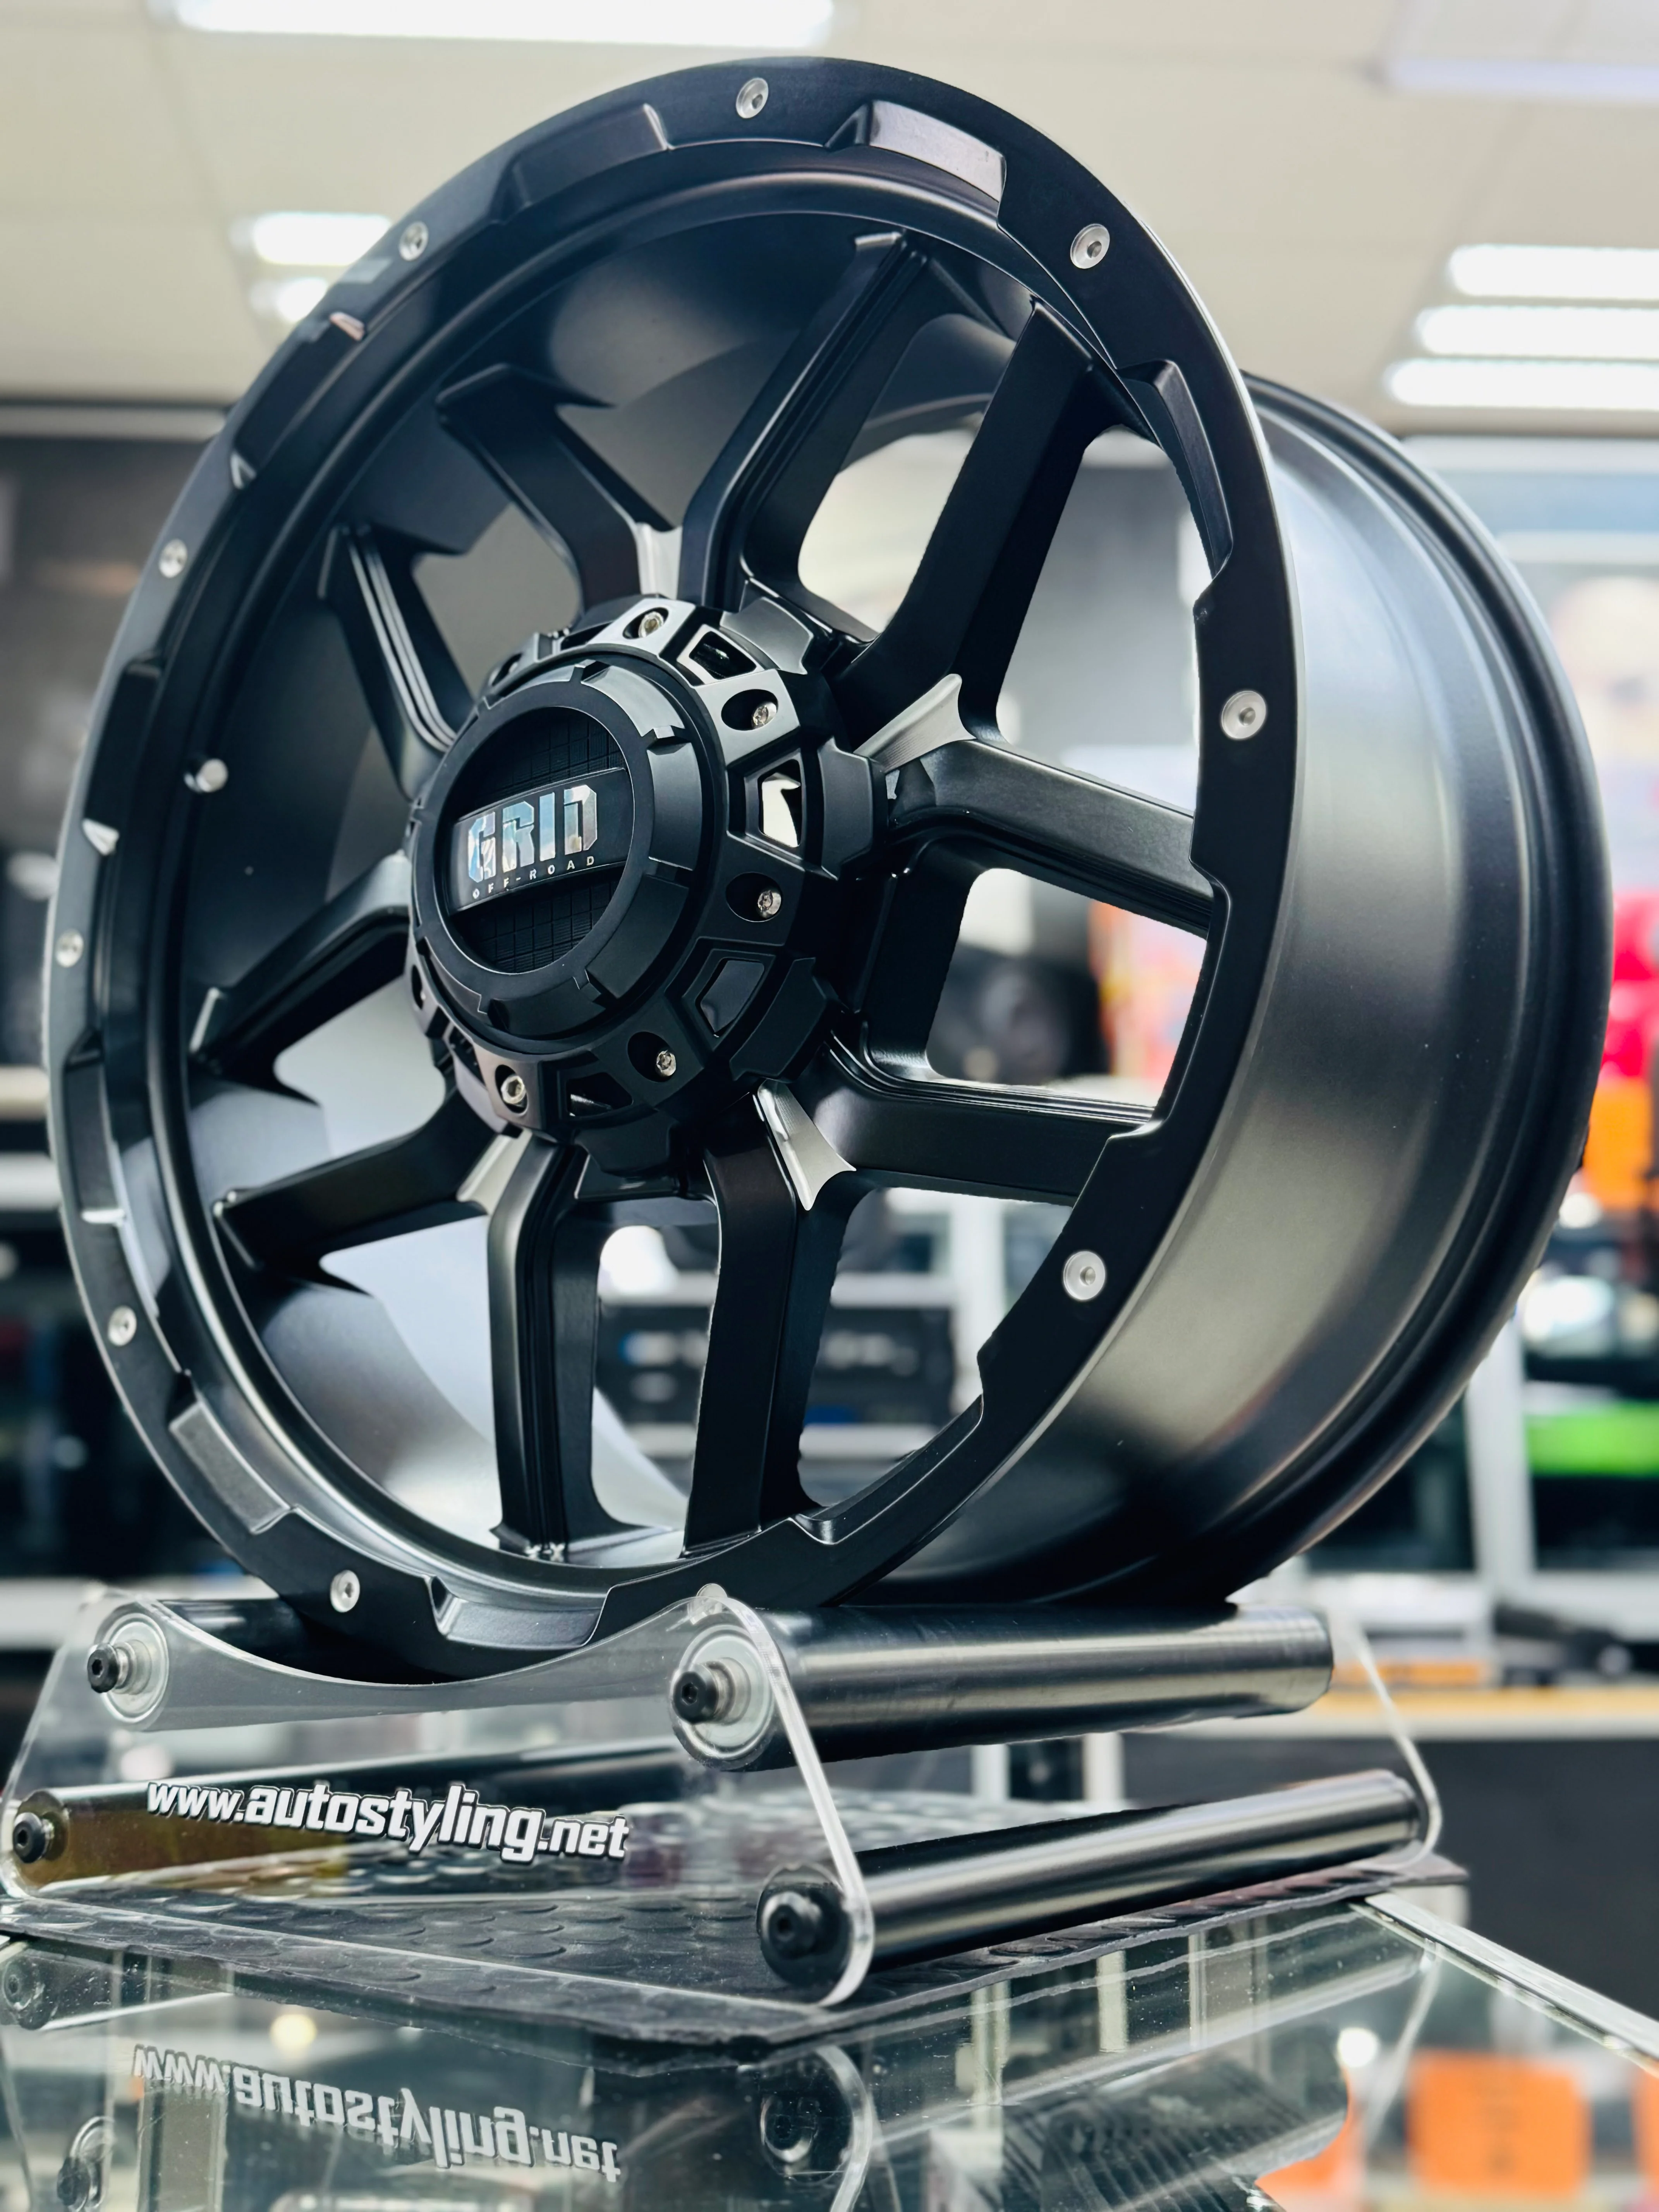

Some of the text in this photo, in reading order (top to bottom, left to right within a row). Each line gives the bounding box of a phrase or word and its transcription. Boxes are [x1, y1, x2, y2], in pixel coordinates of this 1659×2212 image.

[468, 784, 598, 883] GRID
[472, 855, 595, 899] OFF-ROAD
[147, 1781, 629, 1863] www.autostyling.net
